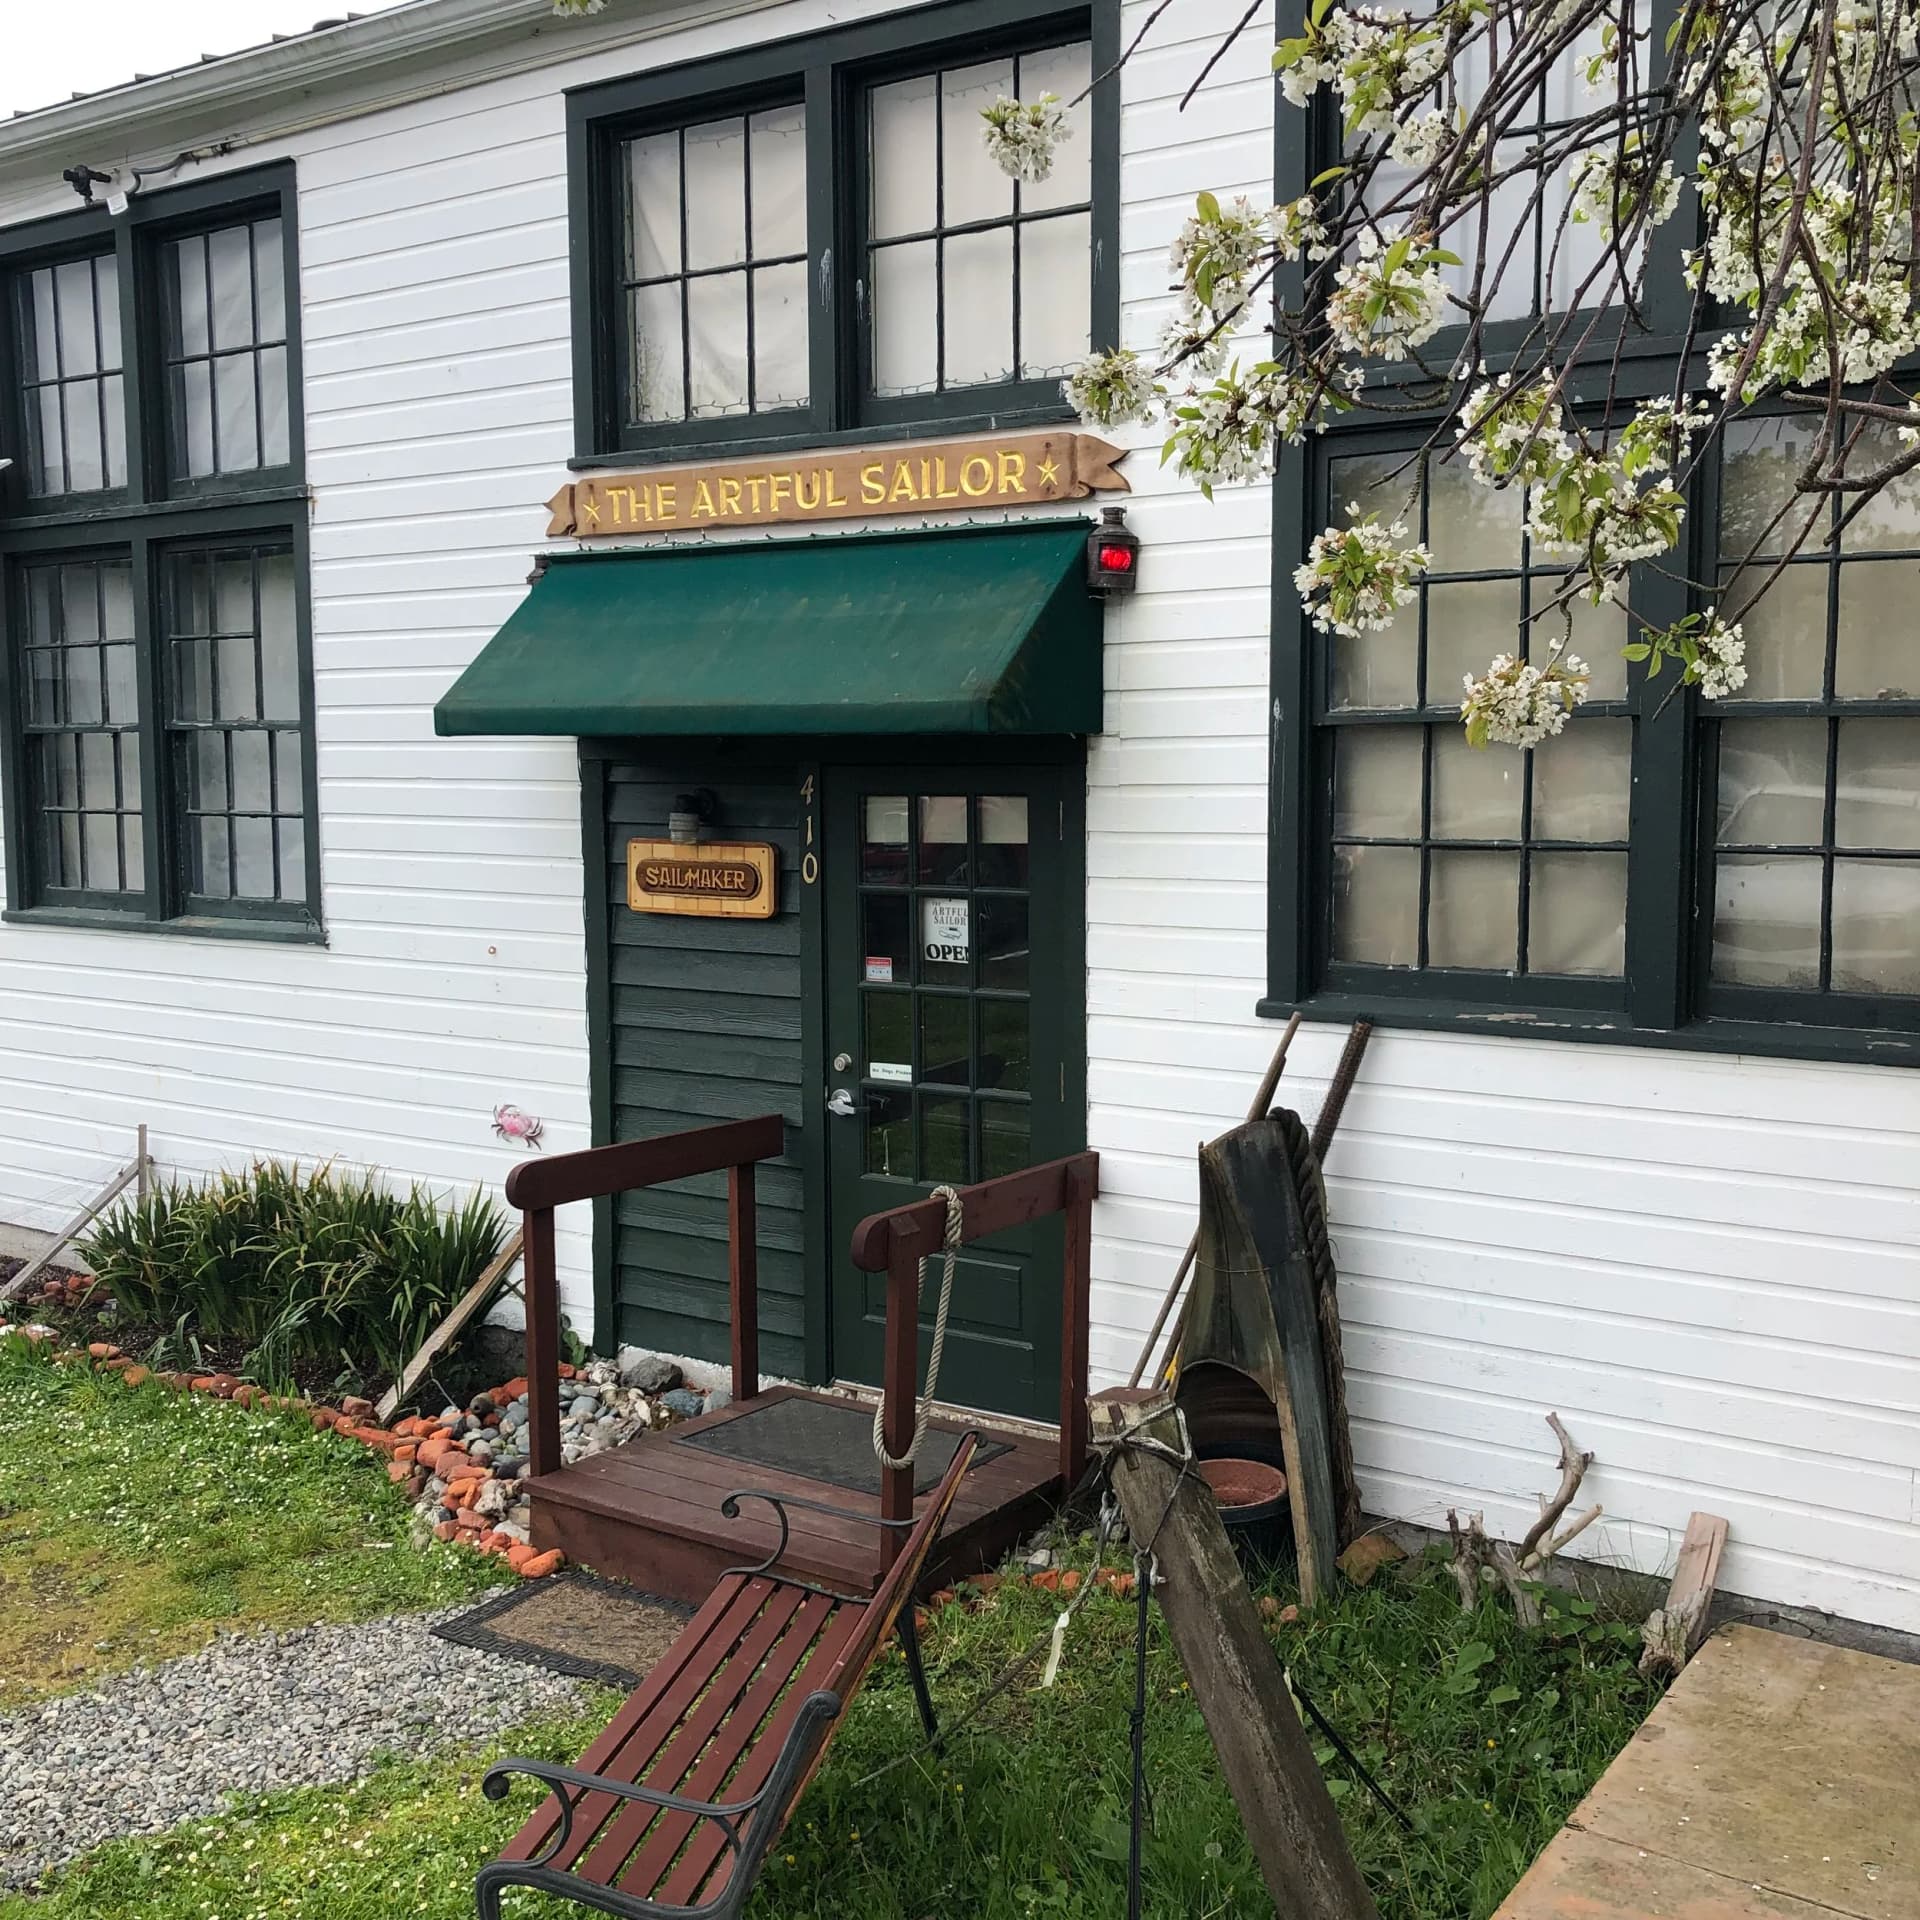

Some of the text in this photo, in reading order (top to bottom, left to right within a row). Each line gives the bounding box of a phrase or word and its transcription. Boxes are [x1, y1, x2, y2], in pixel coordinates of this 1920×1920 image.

[606, 450, 1028, 524] THE ARTFUL SAILOR
[645, 865, 746, 891] SAILMAKER
[932, 906, 968, 917] ARTFUL
[933, 915, 967, 926] SAILOR
